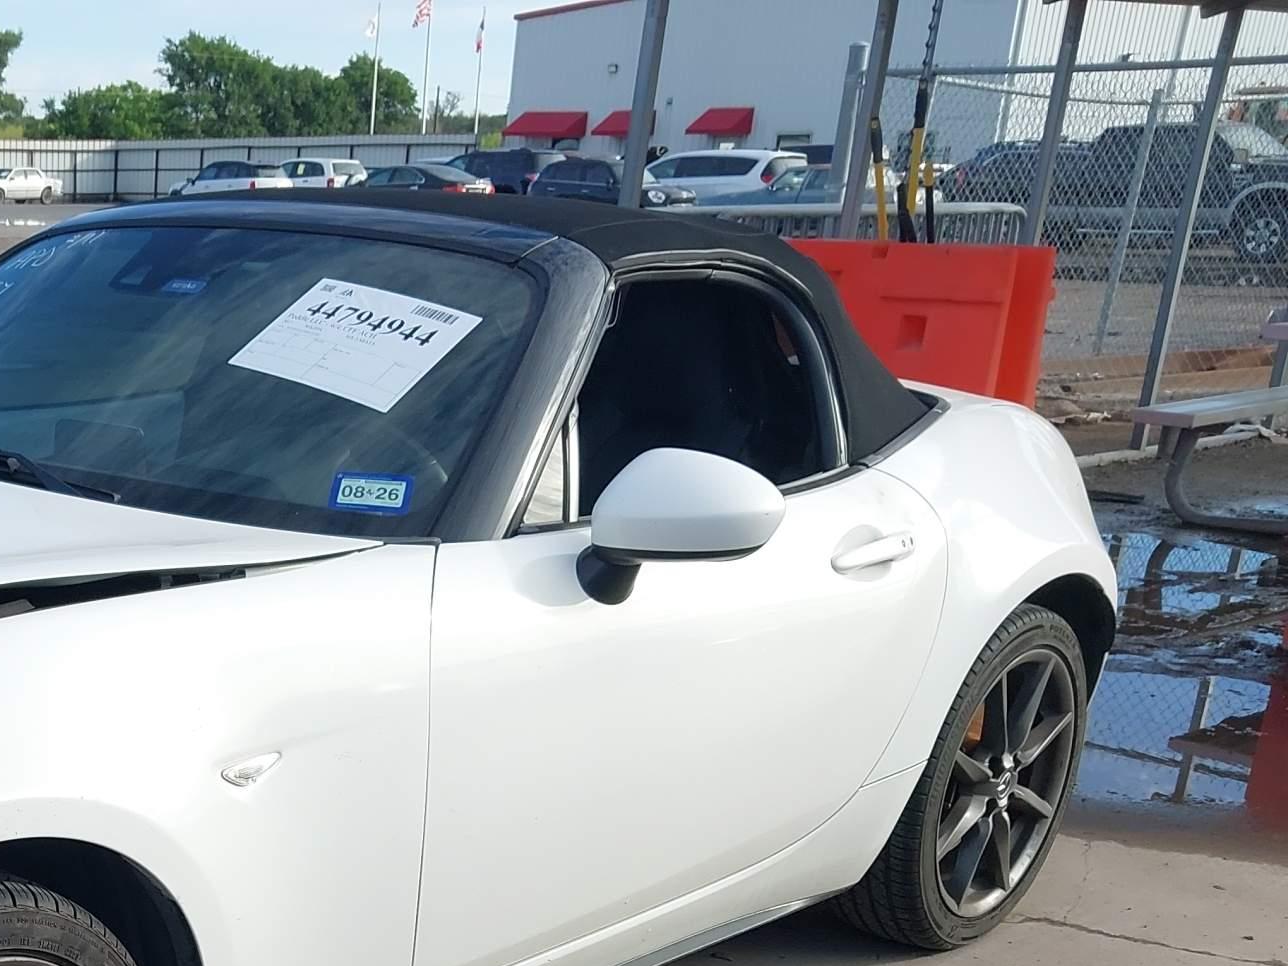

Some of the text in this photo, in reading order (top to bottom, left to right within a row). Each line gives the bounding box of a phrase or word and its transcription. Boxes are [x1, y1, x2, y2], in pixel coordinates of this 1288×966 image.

[306, 301, 439, 346] 44794944
[341, 485, 399, 501] 08 26
